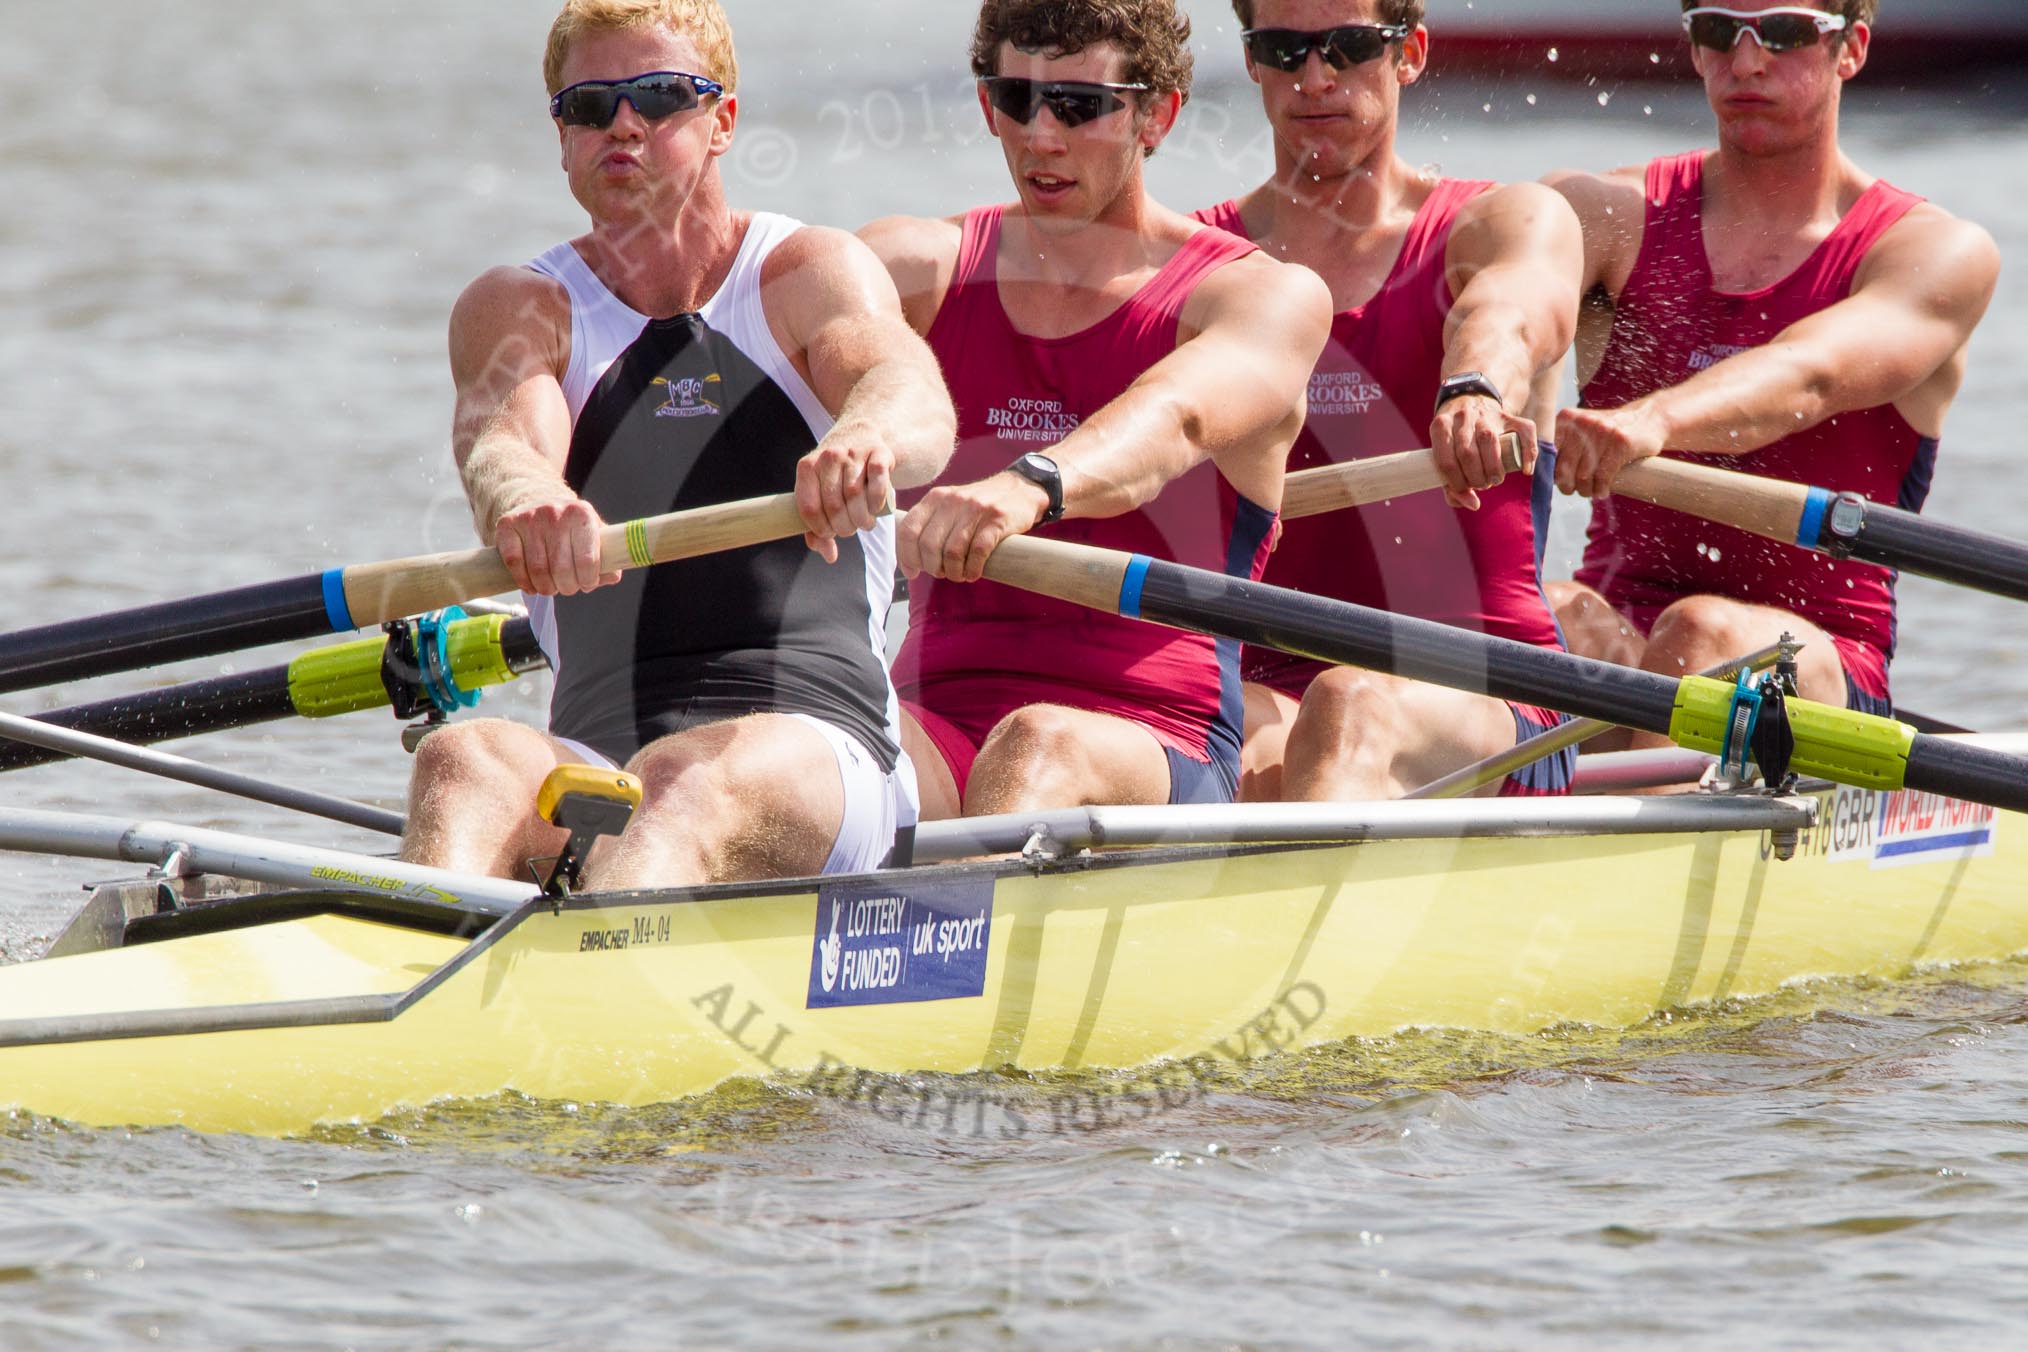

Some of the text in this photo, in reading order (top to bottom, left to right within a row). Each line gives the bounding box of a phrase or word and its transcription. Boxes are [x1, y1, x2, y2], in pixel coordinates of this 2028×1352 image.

[1310, 371, 1361, 386] OXFORD
[1307, 383, 1382, 402] ROOKES
[1008, 397, 1062, 413] OXFORD
[1307, 402, 1369, 415] NIVERSITY
[986, 408, 1079, 430] BROOKES
[997, 427, 1066, 441] UNIVERSITY
[310, 864, 407, 892] EMPACHER
[847, 896, 907, 938] LOTTERY
[579, 928, 630, 953] EMPACHER
[913, 908, 985, 963] uk sport
[841, 946, 900, 991] FUNDED
